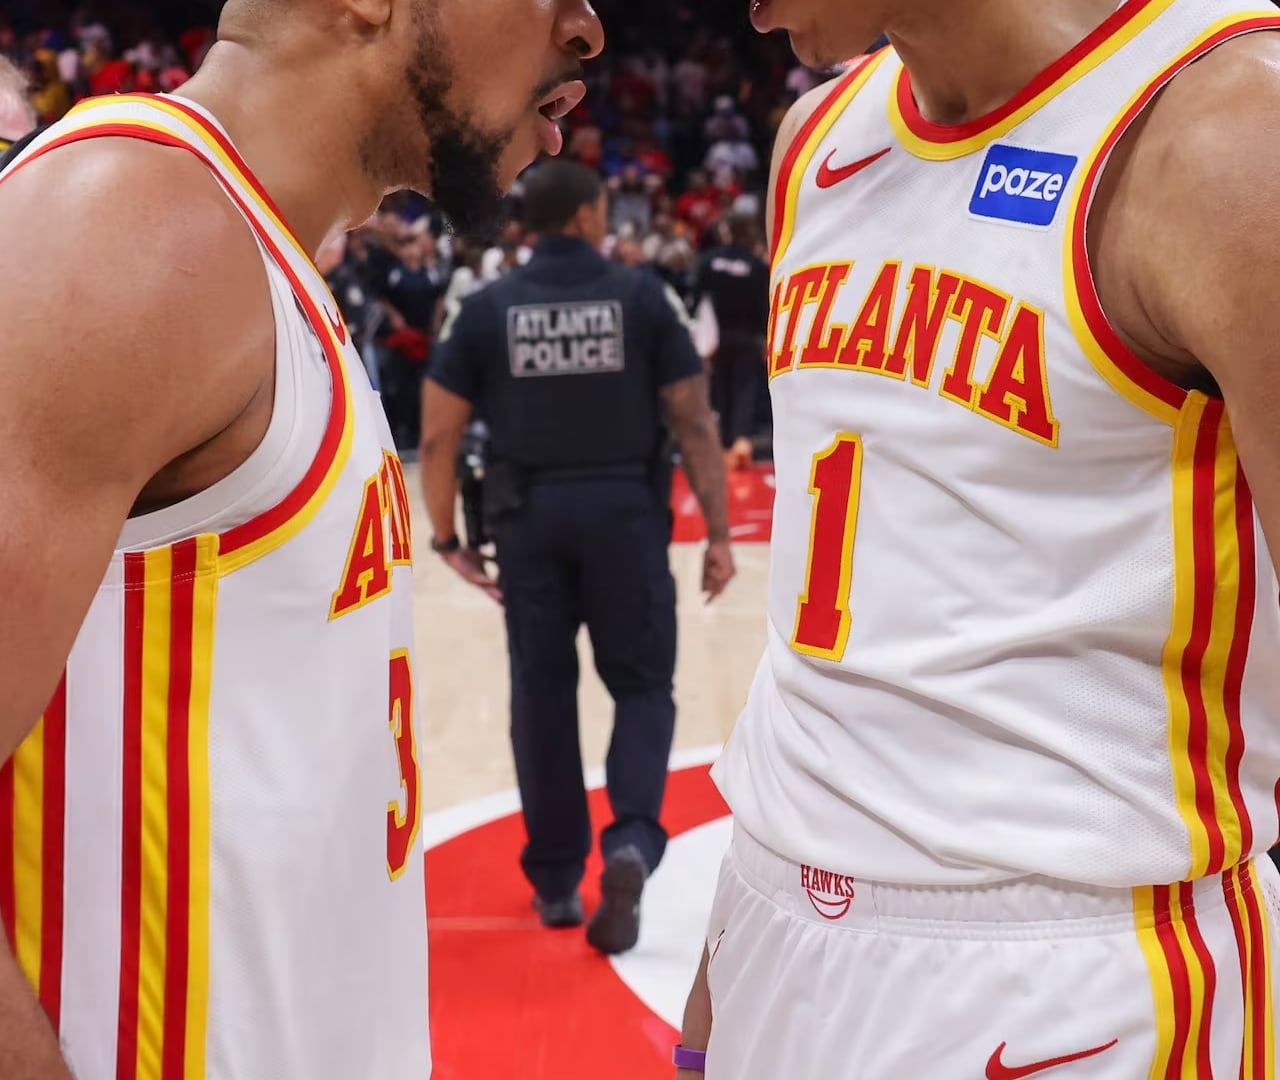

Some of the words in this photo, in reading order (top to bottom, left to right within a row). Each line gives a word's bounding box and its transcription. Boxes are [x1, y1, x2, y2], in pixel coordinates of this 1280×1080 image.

[980, 164, 1064, 202] paze
[513, 306, 617, 339] ATLANTA
[514, 337, 621, 372] POLICE
[792, 431, 863, 662] 1
[386, 647, 421, 882] 3
[800, 863, 855, 899] HAWKS
